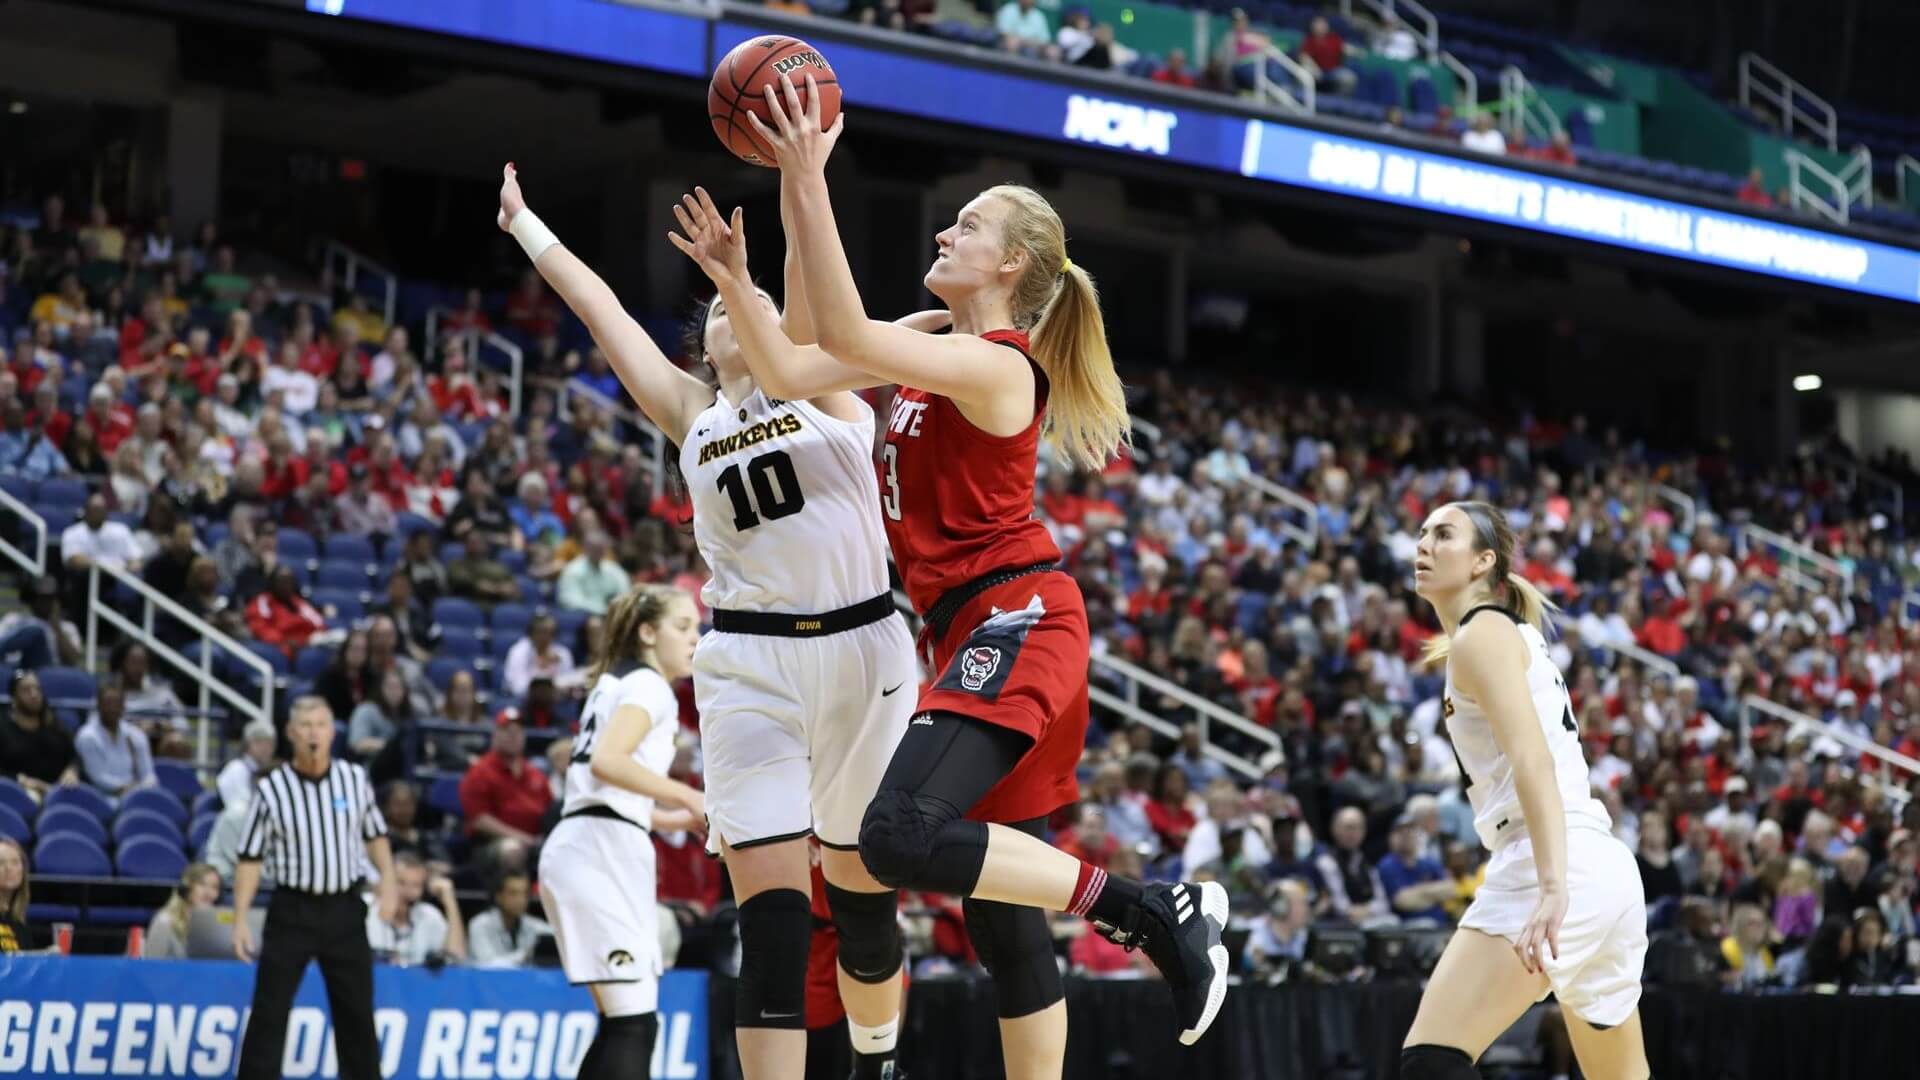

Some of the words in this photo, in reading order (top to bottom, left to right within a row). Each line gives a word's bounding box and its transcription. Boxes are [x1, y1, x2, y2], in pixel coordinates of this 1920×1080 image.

[1066, 98, 1173, 151] NCAA
[1545, 187, 1692, 248] BASKETBALL
[698, 413, 802, 466] HAWKEYES
[716, 450, 805, 532] 10
[795, 620, 822, 630] IOWA
[0, 1000, 408, 1079] GREENSOO
[417, 1008, 698, 1080] REGIOL
